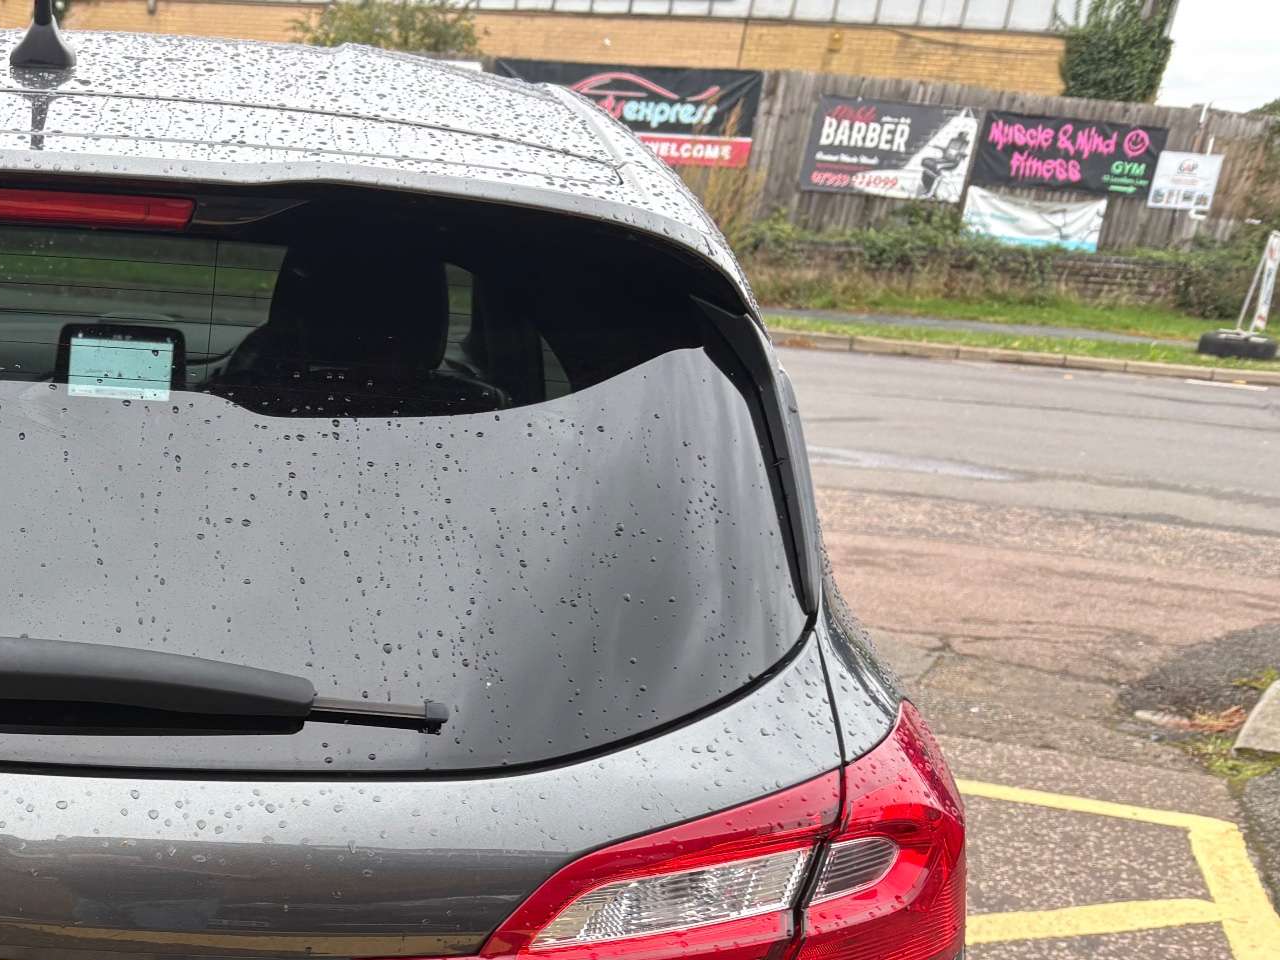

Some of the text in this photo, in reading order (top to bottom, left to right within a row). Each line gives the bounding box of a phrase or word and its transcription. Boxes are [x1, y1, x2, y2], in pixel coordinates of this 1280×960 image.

[622, 100, 718, 128] express
[819, 116, 911, 152] BARBER
[988, 119, 1118, 159] Muscle & Mind
[646, 141, 732, 160] WELCOME
[1110, 161, 1148, 176] GYM
